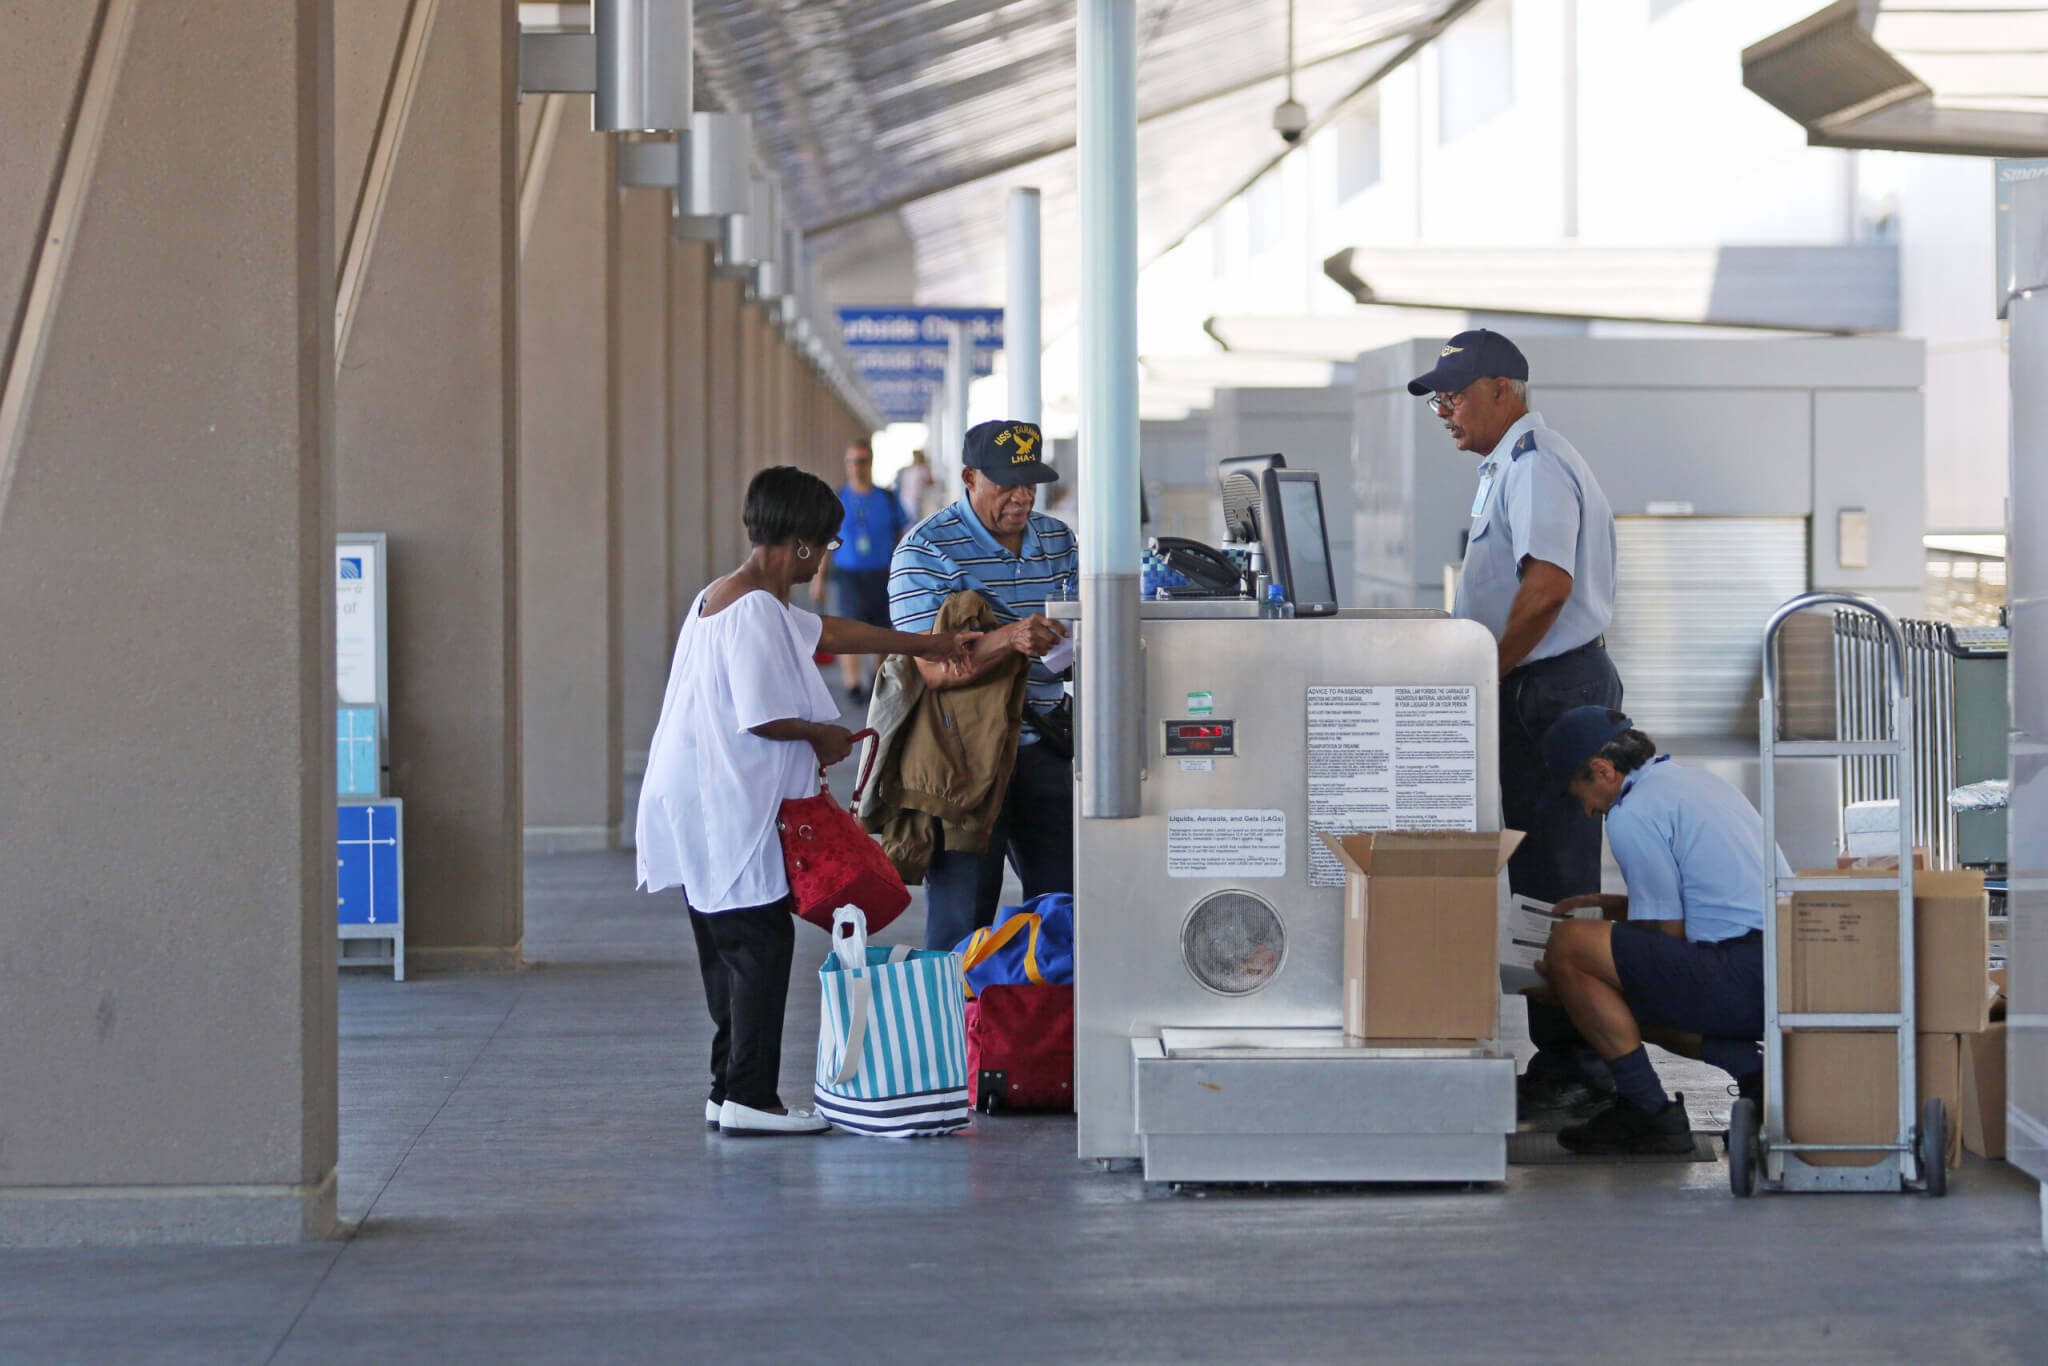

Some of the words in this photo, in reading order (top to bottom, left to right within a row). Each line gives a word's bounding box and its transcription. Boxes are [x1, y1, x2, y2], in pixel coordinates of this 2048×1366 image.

[994, 430, 1012, 446] USS
[1011, 453, 1036, 464] LHA-1
[1169, 815, 1195, 823] Liquids,
[1197, 815, 1227, 823] Aerosols,
[1260, 815, 1284, 823] (LAGs)
